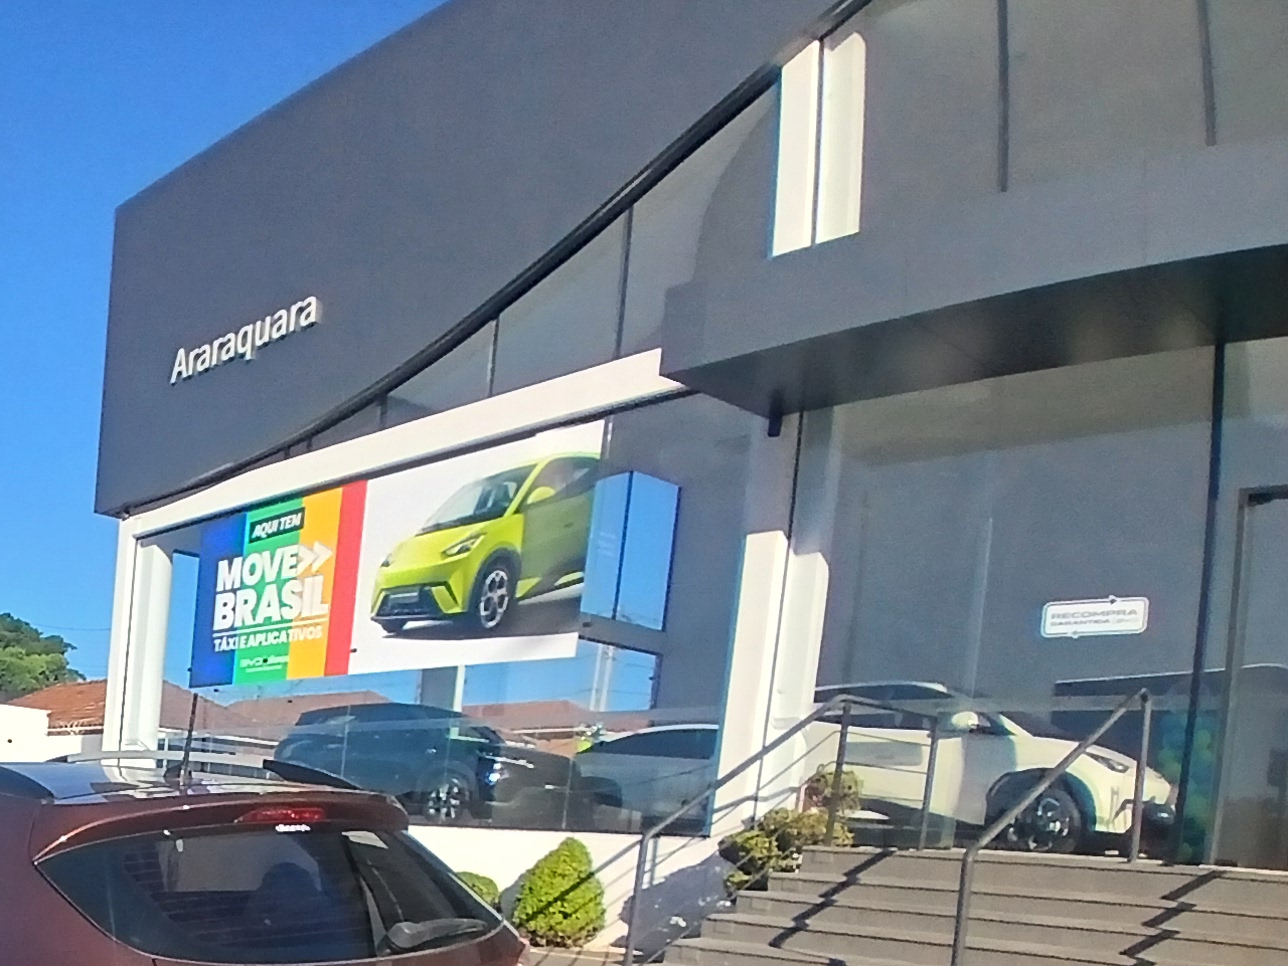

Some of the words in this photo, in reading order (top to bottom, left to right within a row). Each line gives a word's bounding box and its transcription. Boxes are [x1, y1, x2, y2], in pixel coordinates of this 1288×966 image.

[170, 295, 320, 385] Araraquara
[251, 518, 279, 538] AQUI
[280, 512, 303, 531] TEM
[216, 544, 300, 591] MOVE
[213, 575, 329, 631] BRASIL
[1051, 608, 1138, 620] RECOMPRA
[213, 636, 239, 653] TÁXI
[247, 625, 323, 648] APLICATIVOS
